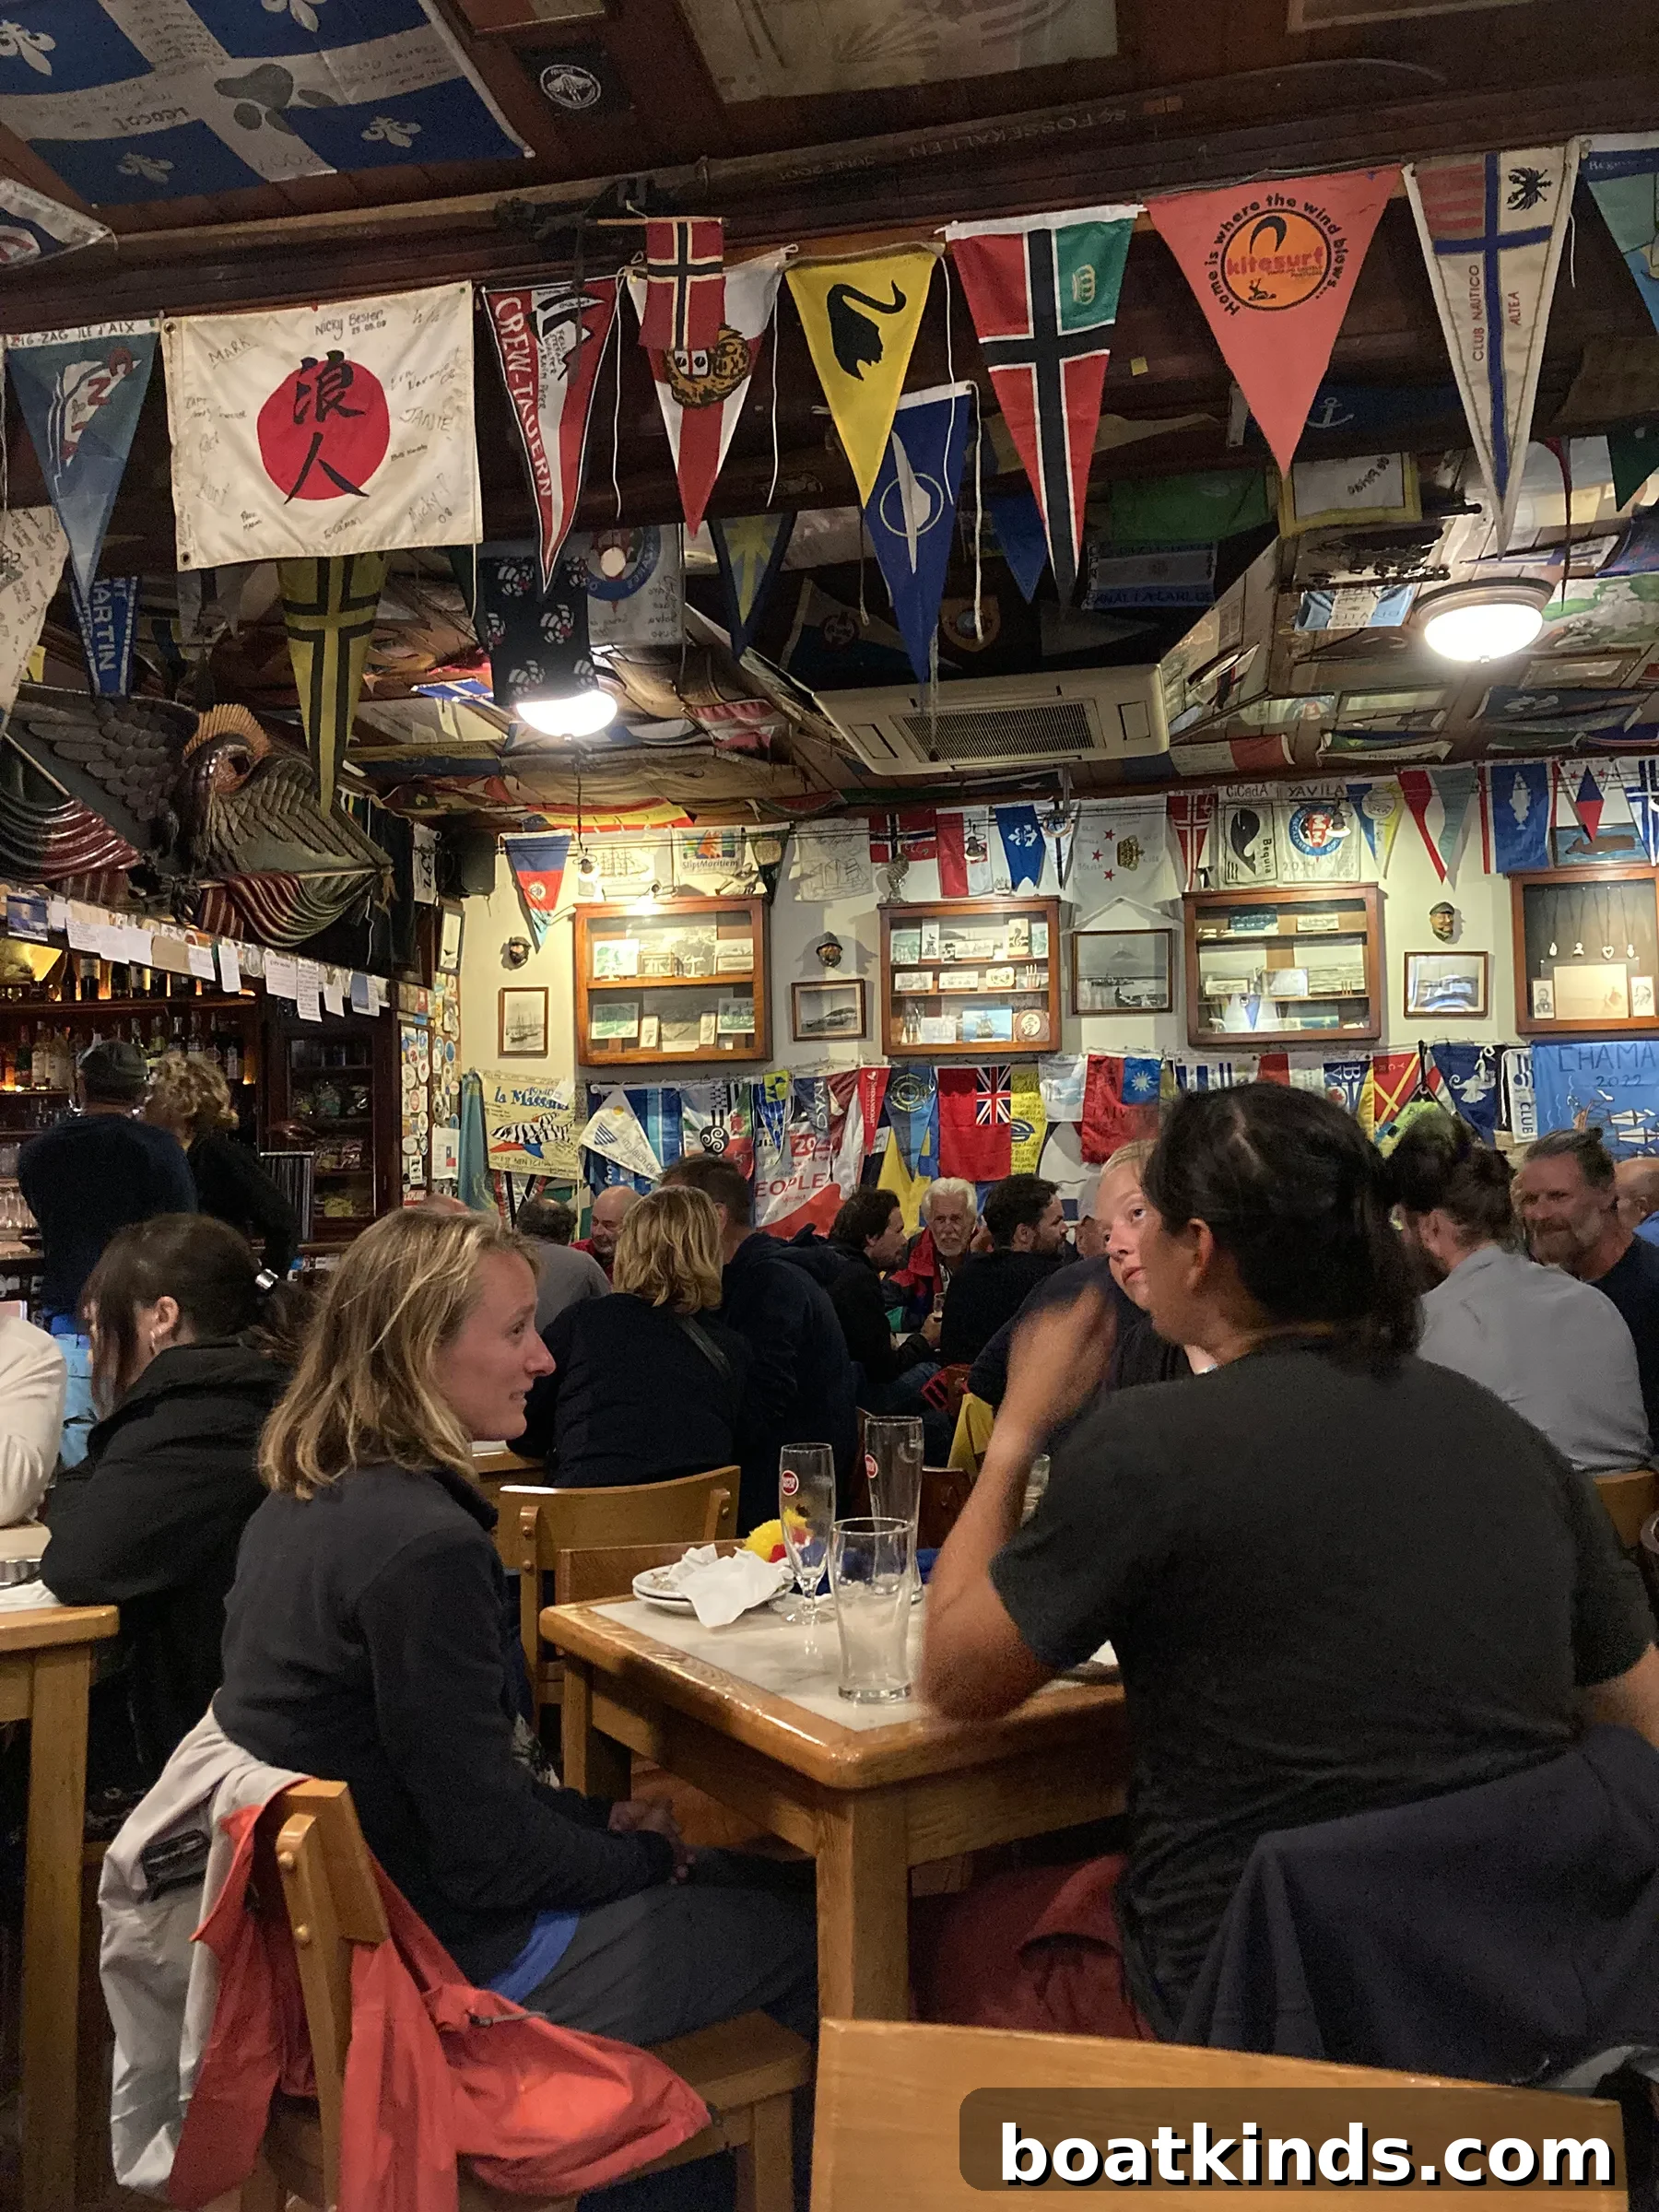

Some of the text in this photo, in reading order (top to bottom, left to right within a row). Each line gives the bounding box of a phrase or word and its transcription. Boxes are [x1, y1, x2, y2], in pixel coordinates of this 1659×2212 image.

[1265, 193, 1297, 207] the
[1214, 201, 1260, 245] where
[1303, 202, 1343, 235] wind
[1204, 251, 1219, 267] is
[1226, 245, 1324, 276] kitesurf
[1208, 270, 1241, 317] Home
[1508, 291, 1522, 326] ALTEA
[1472, 327, 1485, 362] CLUB
[495, 296, 553, 497] CREW-TAUERN
[284, 349, 371, 505] 浪人
[1260, 838, 1272, 875] Bequia
[1595, 1074, 1643, 1088] 2022
[1521, 1101, 1534, 1134] CLUB
[755, 1172, 827, 1198] EOPLE
